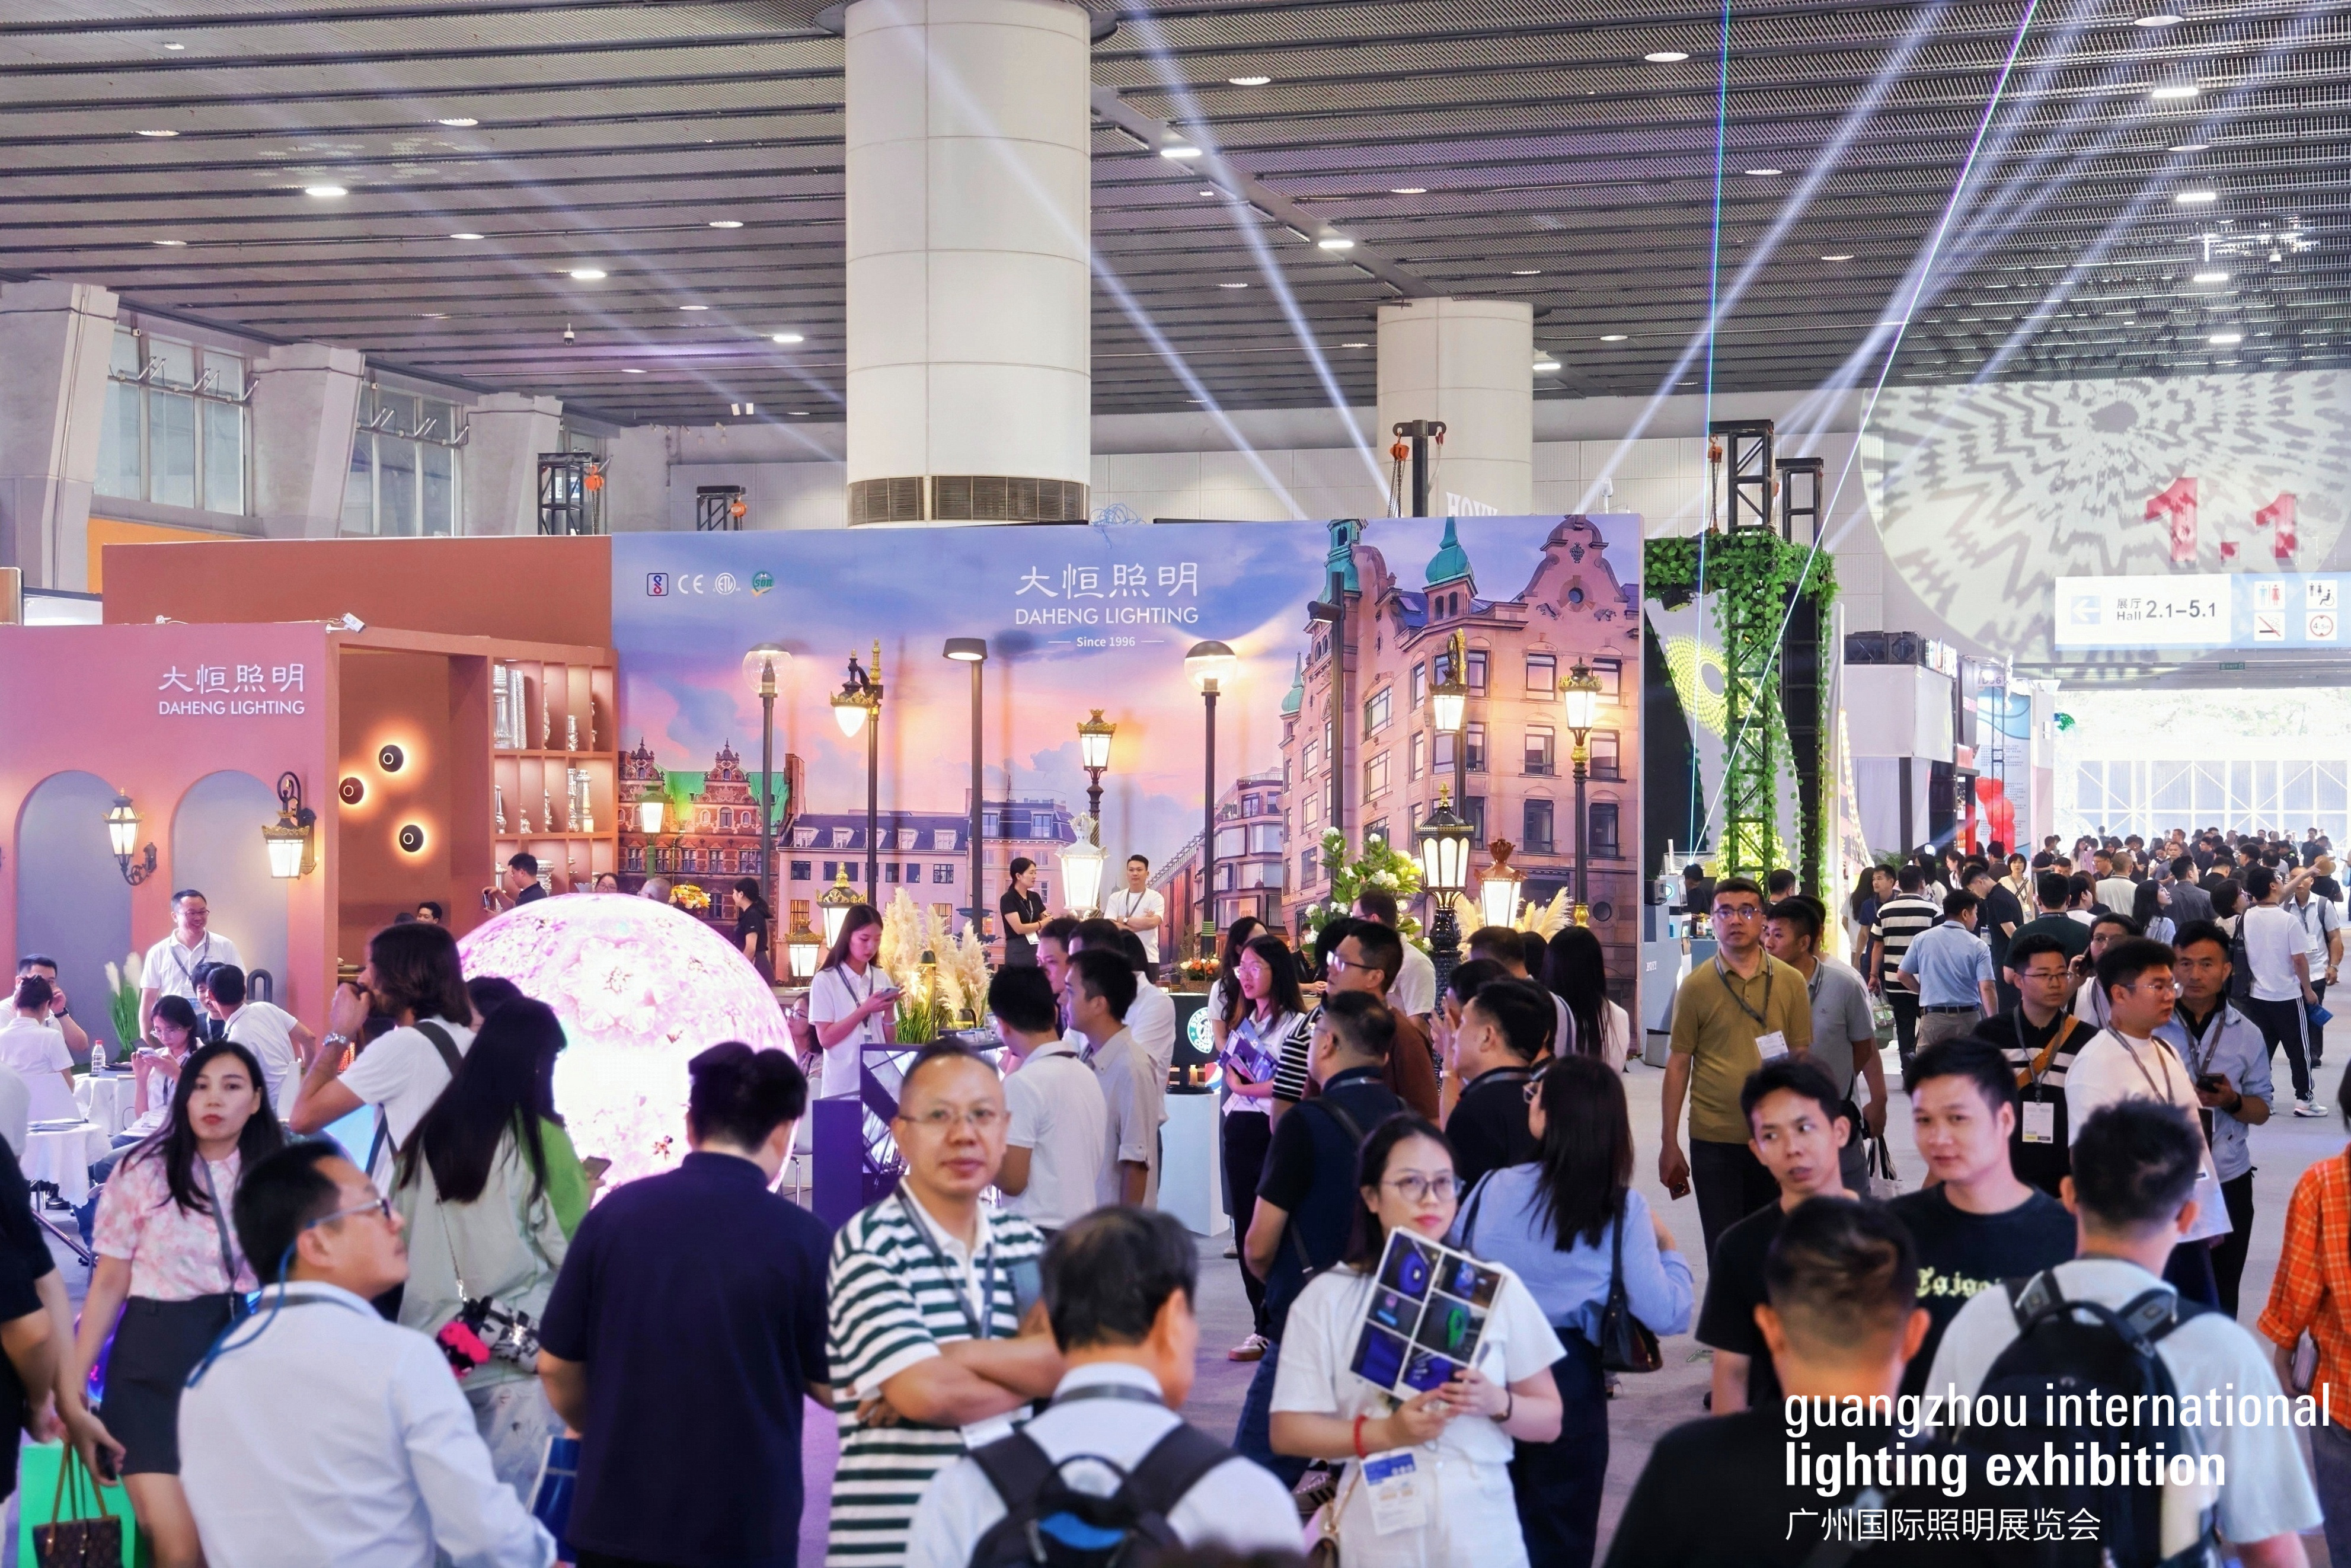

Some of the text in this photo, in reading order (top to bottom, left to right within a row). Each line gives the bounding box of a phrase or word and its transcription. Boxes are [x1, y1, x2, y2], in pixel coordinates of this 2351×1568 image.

[2145, 477, 2296, 561] 1.1
[678, 574, 704, 594] CE
[1015, 562, 1197, 600] 大恒照明
[2117, 598, 2141, 609] 展厅
[1015, 606, 1199, 625] DAHENG LIGHTING
[2117, 611, 2141, 621] Hall
[1077, 636, 1135, 647] Since 1996
[158, 663, 304, 694] 大恒照明
[159, 700, 305, 715] DAHENG LIGHTING
